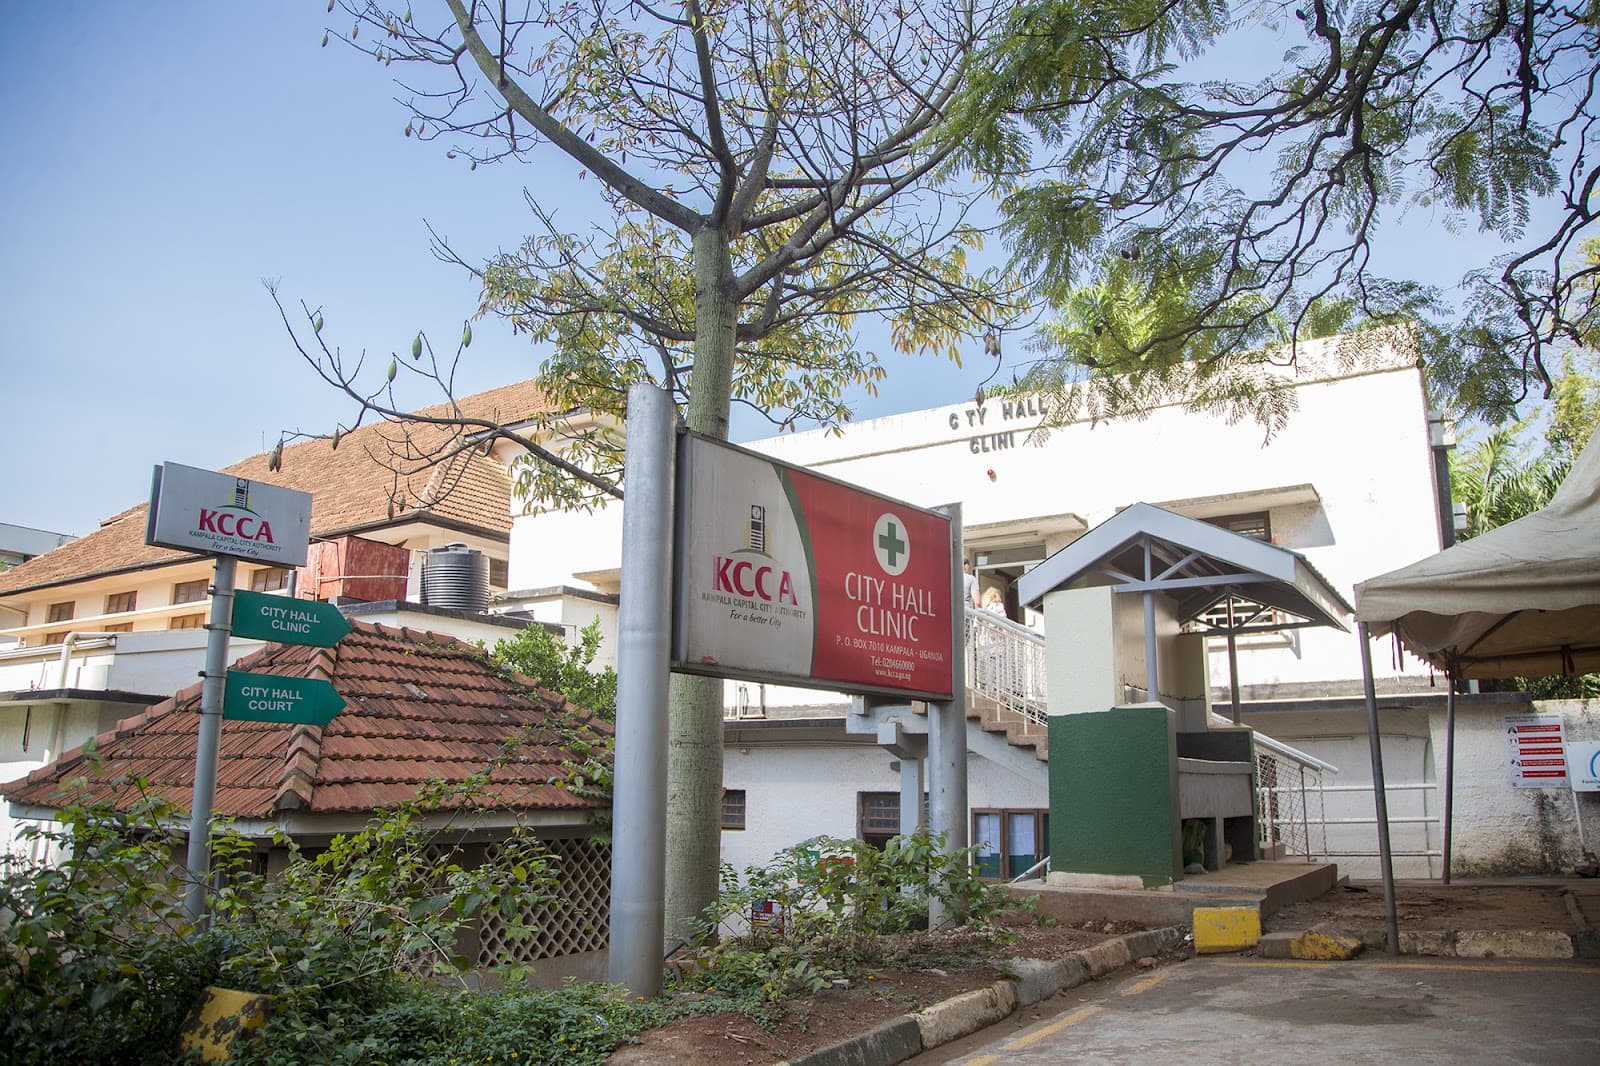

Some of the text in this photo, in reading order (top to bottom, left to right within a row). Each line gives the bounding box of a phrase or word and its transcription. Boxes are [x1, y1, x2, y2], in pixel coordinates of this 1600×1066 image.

[1002, 398, 1049, 421] HALL
[198, 508, 275, 544] KCCA
[189, 530, 282, 553] KAMPALA CAPITAL CITY AUTHORITY
[712, 555, 799, 606] KCCA
[733, 598, 758, 611] CAPITAL
[845, 572, 936, 616] CITY HALL
[260, 606, 321, 624] CITY HALL
[271, 619, 311, 634] CLINIC
[729, 609, 742, 619] For
[749, 612, 768, 624] better
[856, 604, 919, 642] CLINIC
[853, 638, 867, 649] BOX
[868, 640, 885, 652] 7010
[885, 643, 914, 657] KAMPALA
[919, 650, 943, 662] UGANDA
[241, 686, 303, 701] CITY HALL
[248, 699, 294, 712] COURT
